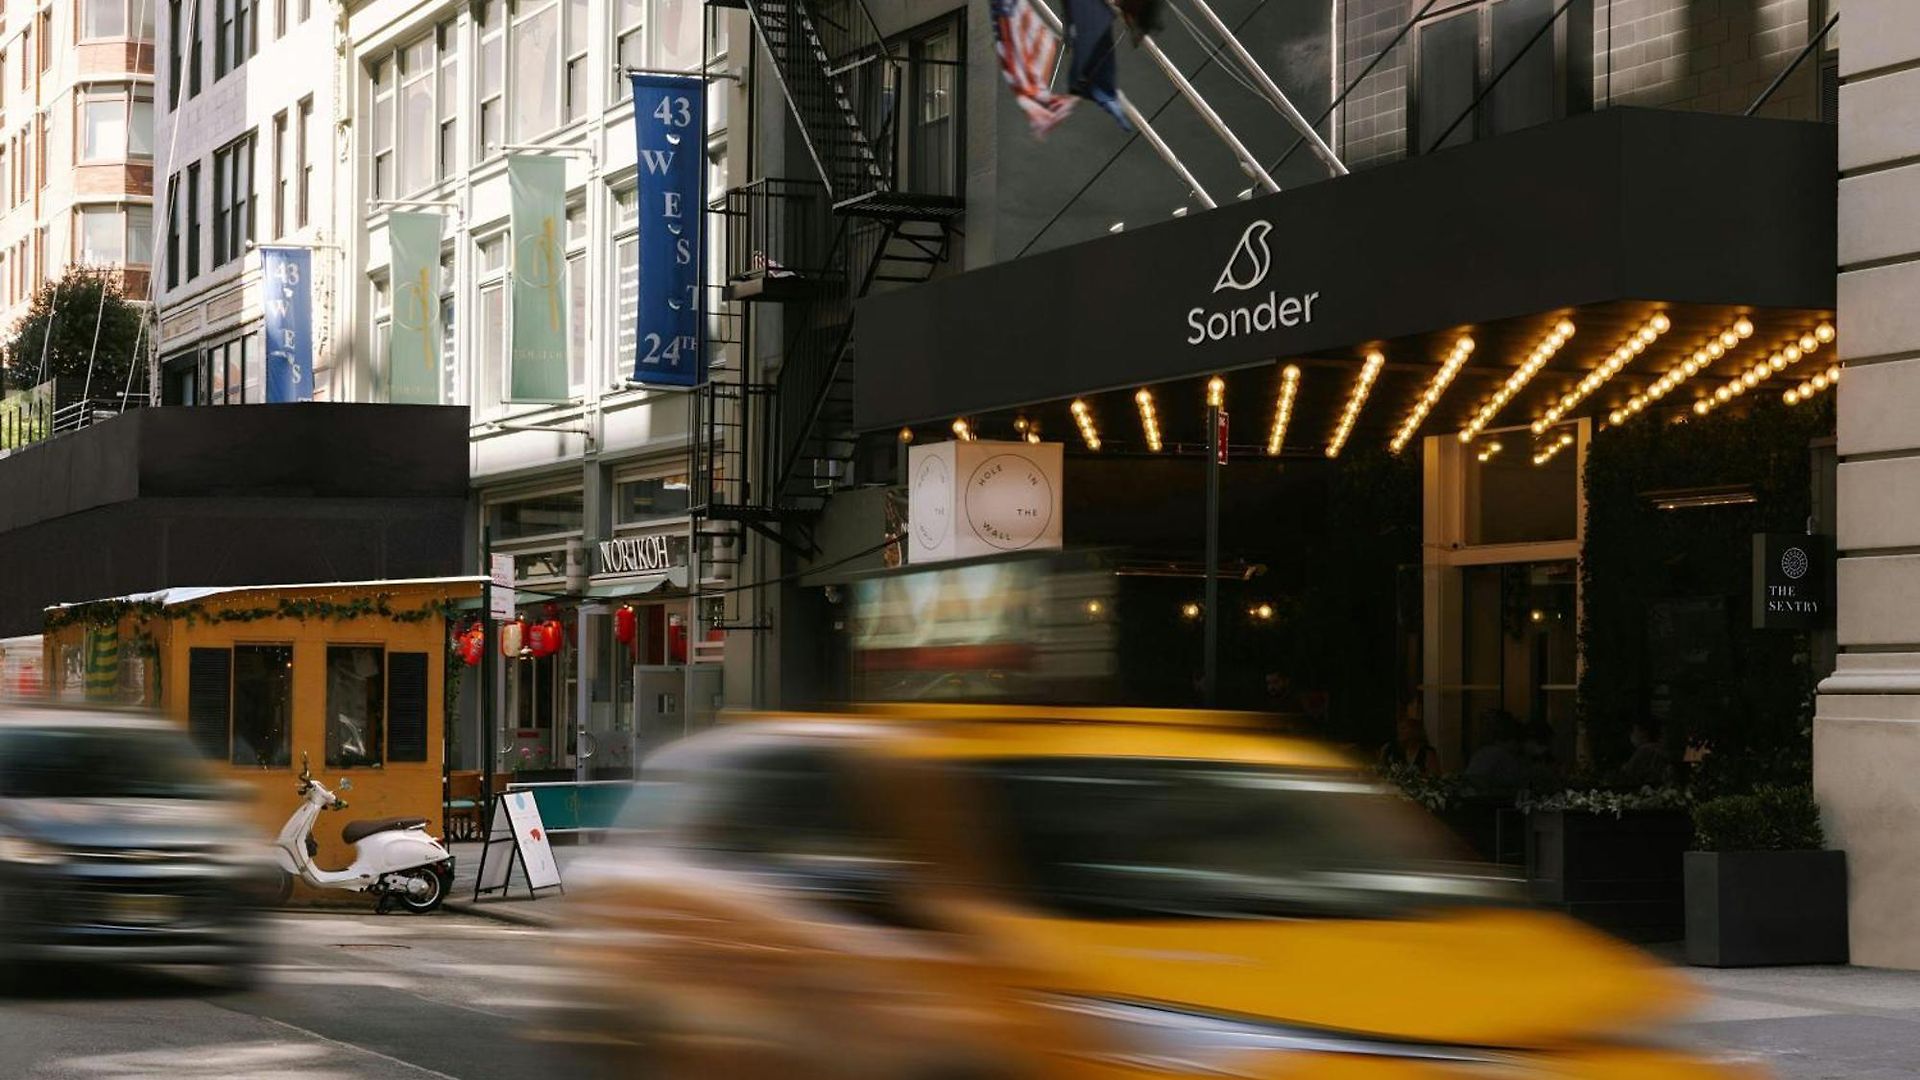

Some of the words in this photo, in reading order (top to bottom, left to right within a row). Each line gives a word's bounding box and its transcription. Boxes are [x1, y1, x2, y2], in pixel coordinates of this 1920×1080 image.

[653, 95, 691, 127] 43
[275, 263, 300, 285] 43
[1187, 290, 1320, 345] Sonder
[978, 463, 1004, 487] HOLE
[1027, 472, 1040, 486] IN
[1016, 508, 1038, 517] THE
[982, 521, 1012, 541] WALL
[599, 536, 670, 572] NORIKOH
[1768, 585, 1796, 597] THE
[1768, 601, 1819, 613] SENTRY
